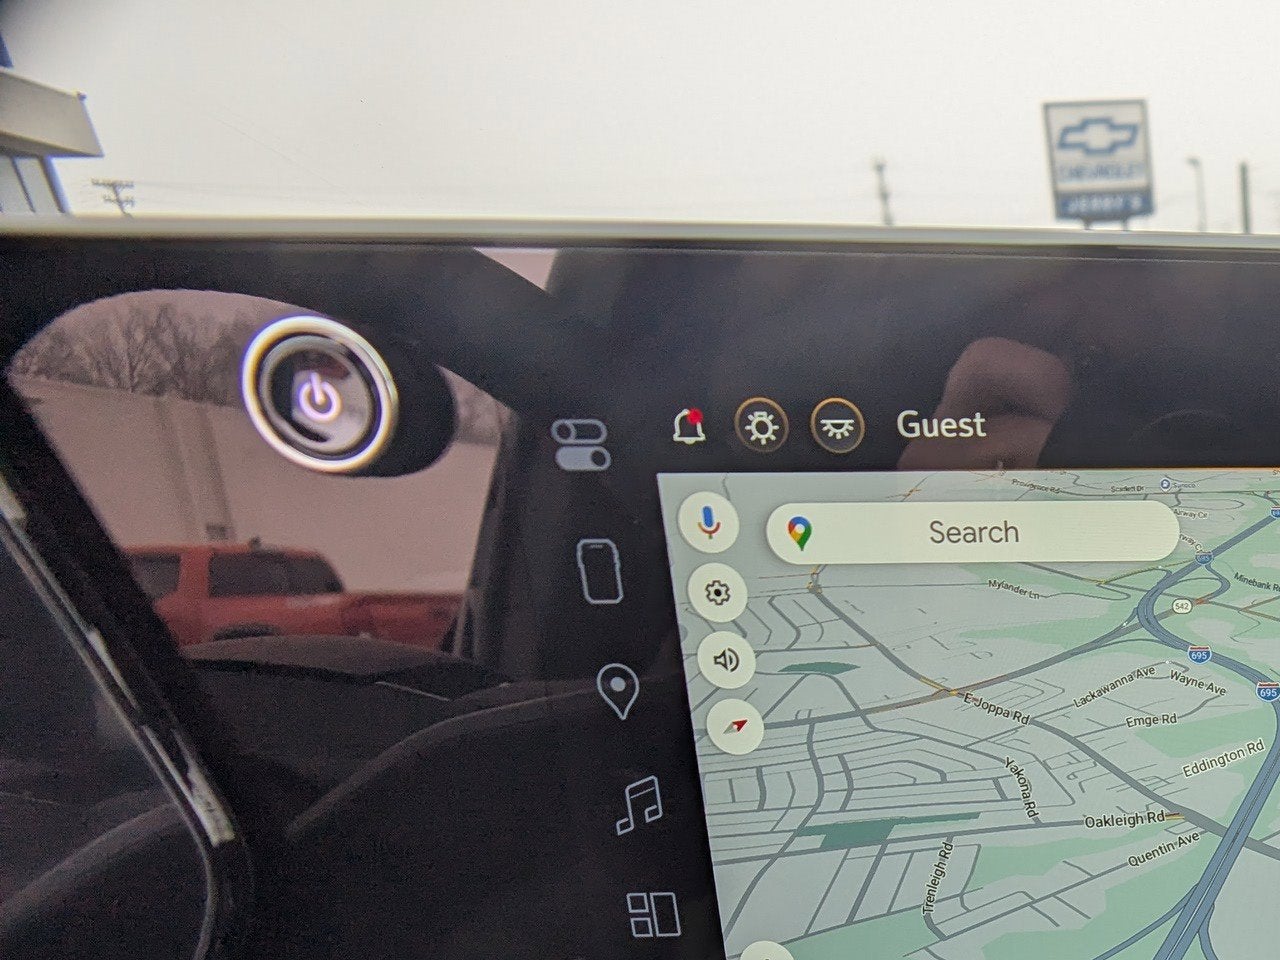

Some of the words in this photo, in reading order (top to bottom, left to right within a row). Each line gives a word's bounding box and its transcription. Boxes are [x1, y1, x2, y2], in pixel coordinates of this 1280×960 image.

[896, 409, 987, 439] Guest
[928, 519, 1020, 545] Search
[987, 578, 1028, 599] Mylander
[1028, 588, 1040, 600] Ln
[1233, 571, 1271, 591] Minebank
[1174, 602, 1189, 611] 542
[1190, 650, 1208, 661] 695
[1073, 674, 1134, 709] Lackawanna
[1135, 666, 1156, 681] Ave
[1169, 669, 1204, 691] Wayne
[1205, 682, 1227, 696] Ave
[1260, 687, 1277, 698] 695
[963, 692, 973, 704] E
[974, 696, 1010, 720] Joppa
[1012, 710, 1031, 726] Rd
[1125, 715, 1158, 729] Emge
[1160, 713, 1178, 725] Rd
[1182, 744, 1245, 778] Eddington
[1246, 739, 1265, 757] Rd
[1004, 756, 1031, 801] Yakona
[1023, 799, 1039, 819] Rd
[1084, 812, 1145, 830] Oakleigh
[1146, 809, 1166, 824] Rd
[1127, 843, 1175, 868] Quentin
[1177, 831, 1200, 848] Ave
[922, 859, 947, 915] Trenleigh
[942, 842, 954, 860] Rd
